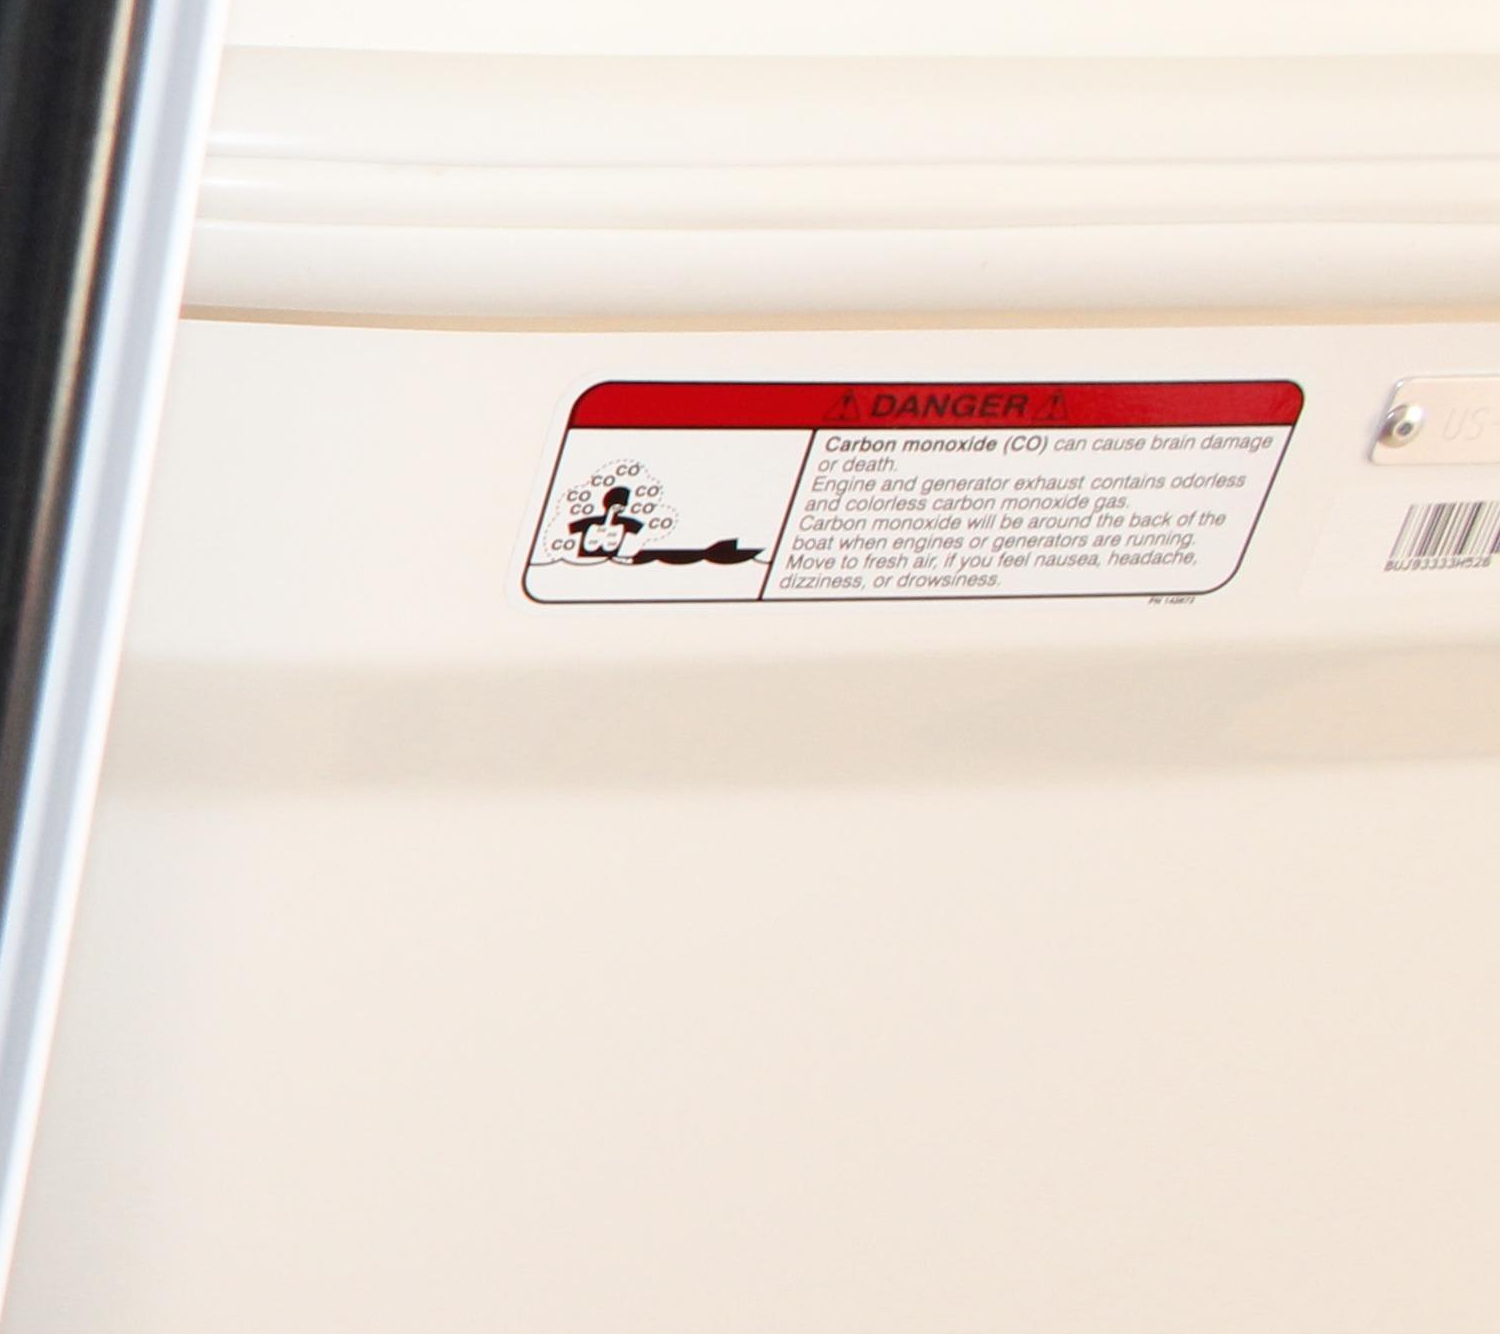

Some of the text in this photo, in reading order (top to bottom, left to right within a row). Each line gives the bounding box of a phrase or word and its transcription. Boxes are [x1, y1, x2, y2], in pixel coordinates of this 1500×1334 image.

[871, 394, 1028, 417] DANGER
[825, 434, 1273, 455] Carbon monoxide (CO) can cause brain damage
[616, 465, 640, 476] CO
[817, 457, 897, 472] or death.
[591, 475, 615, 486] CO
[812, 474, 1247, 495] Engine and generator exhaust contains odorless
[567, 491, 591, 501] CO
[635, 486, 659, 497] CO
[570, 504, 594, 515] CO
[631, 503, 654, 514] CO
[805, 495, 1129, 513] and colorless carbon monoxide gas.
[649, 518, 672, 529] CO
[799, 510, 1226, 531] Carbon monoxide will be around the back of the
[552, 539, 575, 550] CO
[792, 532, 1195, 553] boat when engines or generators are running.
[786, 550, 1197, 572] Move to fresh air, if you feel nausea, headache,
[779, 571, 1000, 590] dizziness, or drowsiness.
